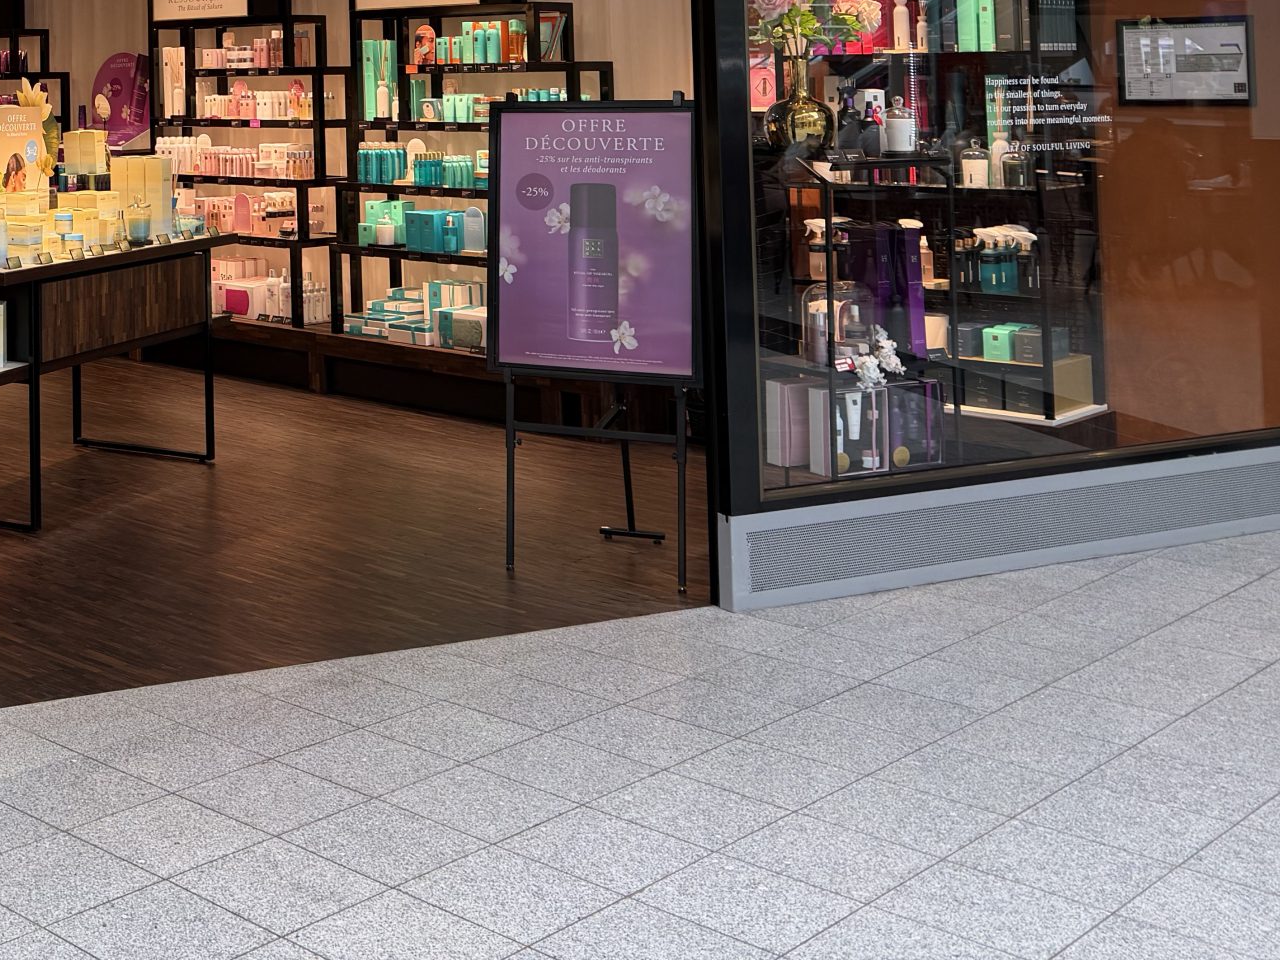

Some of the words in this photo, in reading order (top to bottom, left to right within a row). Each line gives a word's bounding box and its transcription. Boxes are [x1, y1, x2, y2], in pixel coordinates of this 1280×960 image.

[985, 77, 1018, 87] Happiness
[1032, 76, 1039, 84] be
[1041, 76, 1059, 84] found
[1006, 90, 1031, 99] smallest
[1033, 90, 1040, 98] of
[1041, 90, 1063, 99] things.
[1045, 103, 1058, 111] turn
[1060, 102, 1087, 112] everyday
[1015, 117, 1028, 125] into
[1046, 115, 1081, 124] meaningful
[1082, 114, 1112, 123] moments.
[561, 119, 626, 133] OFFRE
[525, 135, 665, 151] DÉCOUVERTE
[1021, 143, 1031, 152] OF
[1032, 142, 1064, 151] SOULFUL
[1065, 141, 1091, 150] LIVING
[536, 155, 556, 164] -25%
[572, 155, 583, 164] les
[584, 156, 653, 166] anti-transpirants
[570, 165, 581, 173] les
[582, 165, 627, 174] déodorants
[522, 187, 549, 197] -25%
